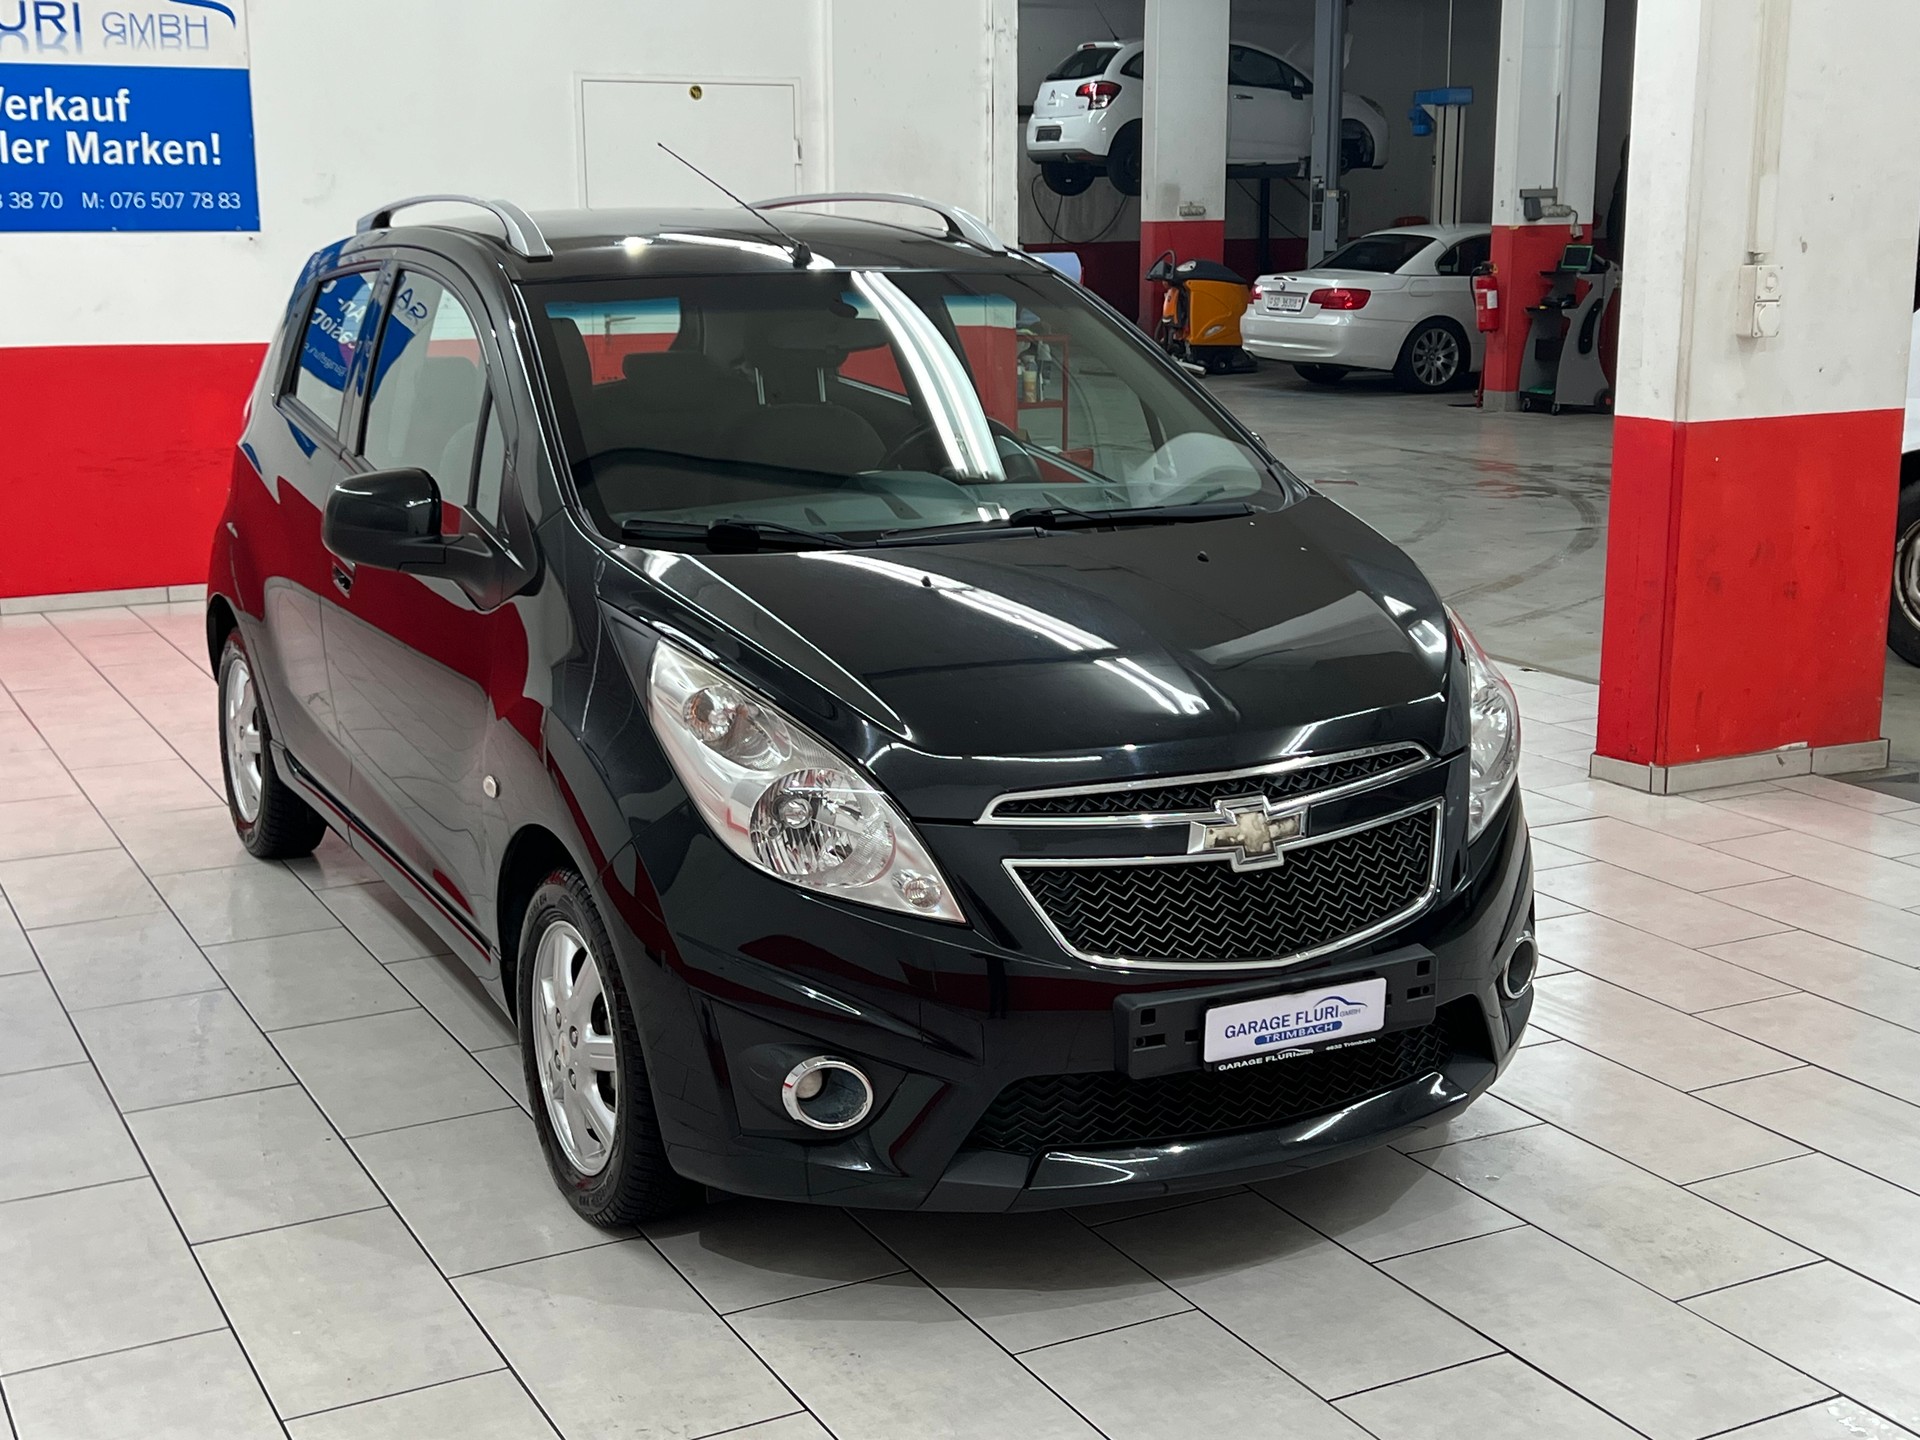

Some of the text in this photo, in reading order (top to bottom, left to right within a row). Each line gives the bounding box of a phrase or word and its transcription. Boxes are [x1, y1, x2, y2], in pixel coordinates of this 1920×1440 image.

[102, 11, 208, 37] GMBH
[0, 87, 130, 122] erkauf
[66, 131, 222, 166] Marken!
[8, 191, 34, 209] 38
[38, 191, 64, 209] 70
[82, 191, 105, 209] M:
[110, 191, 146, 209] 076
[151, 191, 184, 209] 507
[191, 192, 214, 209] 78
[218, 191, 241, 209] 83
[1225, 1013, 1291, 1039] GARAGE
[1295, 1004, 1339, 1026] FLURI
[1264, 1023, 1334, 1043] TRIMBACH
[1217, 1057, 1263, 1071] GARAGE
[1265, 1051, 1296, 1063] FLURI
